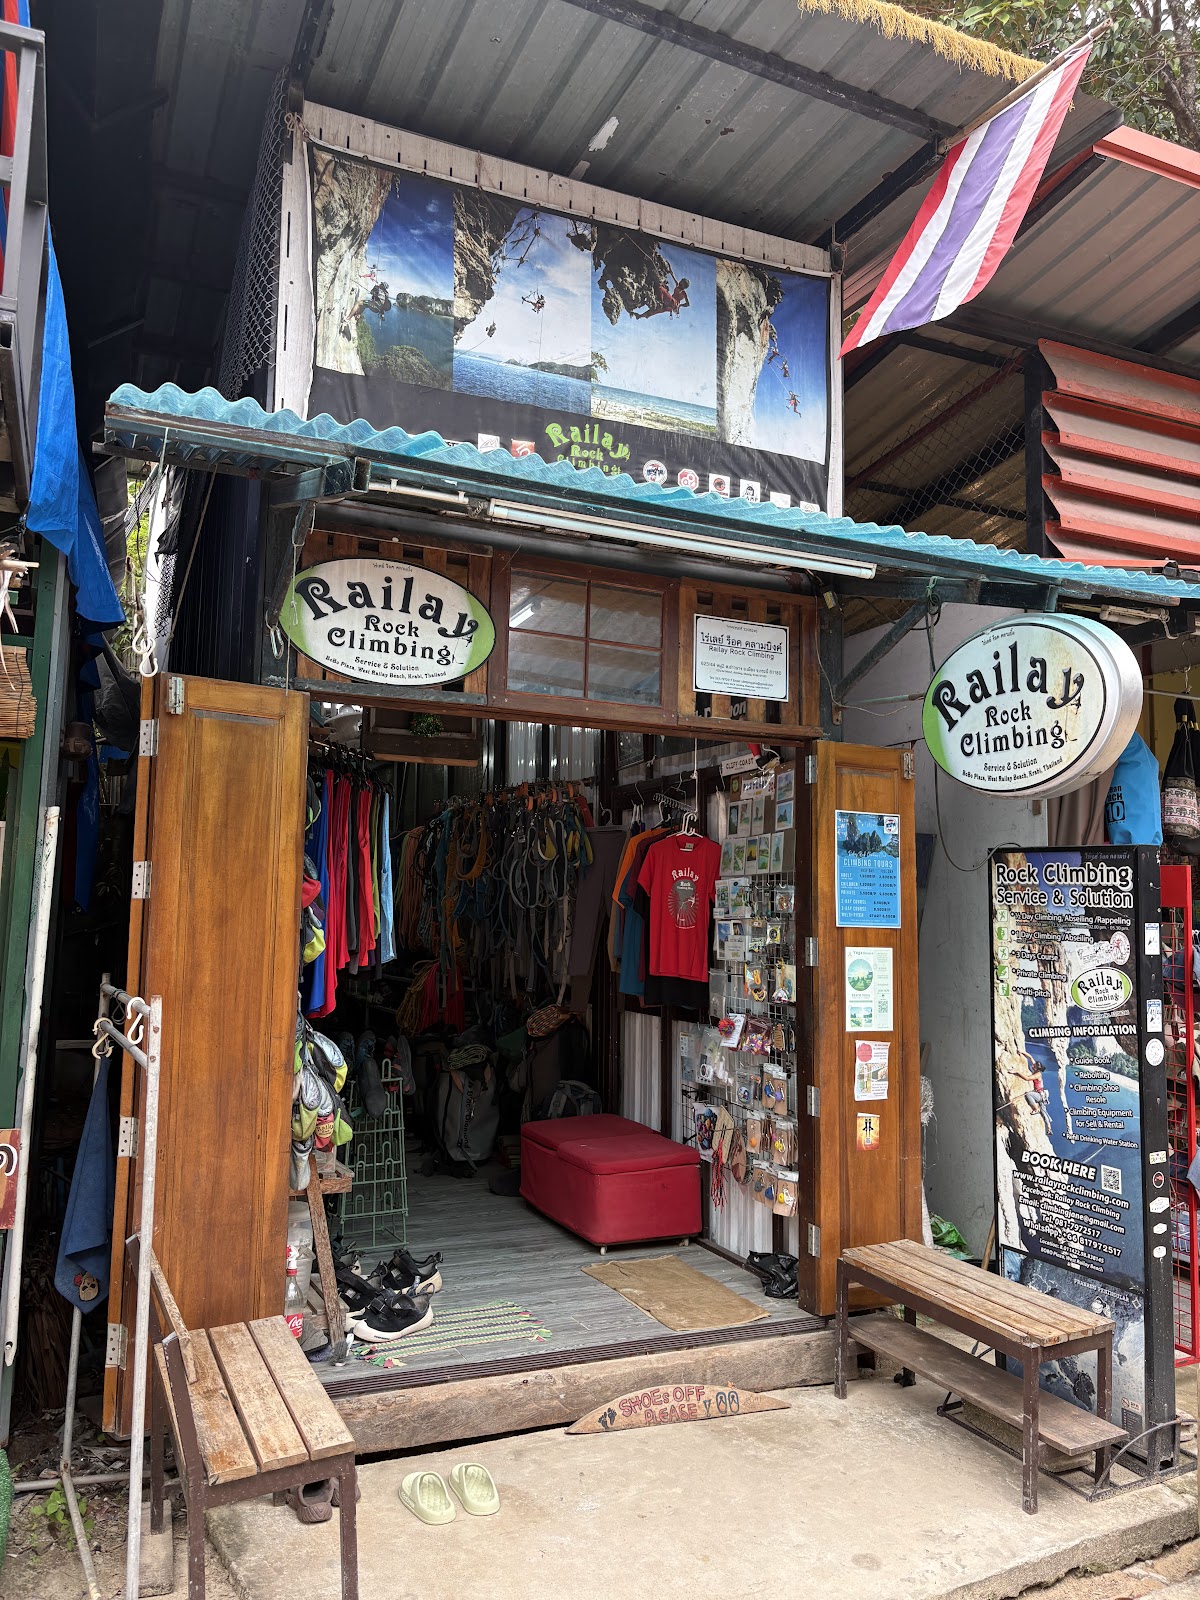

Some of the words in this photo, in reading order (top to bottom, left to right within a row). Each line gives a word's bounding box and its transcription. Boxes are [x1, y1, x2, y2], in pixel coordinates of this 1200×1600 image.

[545, 423, 631, 461] Railay
[570, 444, 604, 461] Rock
[295, 575, 479, 638] Railay
[364, 614, 420, 637] Rock
[327, 627, 452, 666] Climbing
[708, 645, 728, 655] Railay
[729, 648, 746, 656] Rock
[747, 650, 775, 661] Climbing
[354, 656, 381, 668] Service
[390, 663, 420, 671] Solution
[931, 641, 1085, 732] Railay
[984, 699, 1032, 727] Rock
[960, 720, 1066, 757] Climbing
[983, 762, 1006, 772] Service
[1006, 761, 1011, 770] &
[1012, 757, 1038, 770] Solution
[843, 858, 872, 867] CLIMBING
[874, 860, 893, 868] TOURS
[671, 867, 699, 882] Railay
[995, 863, 1039, 884] Rock
[1043, 863, 1132, 890] Climbing
[996, 888, 1047, 905] Service
[1052, 889, 1064, 906] &
[1070, 888, 1133, 908] Solution
[1022, 912, 1034, 920] Day
[1020, 931, 1033, 940] Day
[1033, 932, 1061, 941] Climbing
[1021, 952, 1037, 960] Days
[1037, 951, 1059, 961] Course
[1016, 968, 1038, 979] Private
[1039, 970, 1067, 982] Climbing
[1077, 971, 1123, 995] Railay
[1016, 986, 1051, 998] Multi-pitch
[1087, 993, 1119, 1003] Climbing
[1094, 987, 1109, 995] Rock
[1029, 1027, 1071, 1038] CLIMBING
[1073, 1025, 1137, 1036] INFORMATION
[1074, 1057, 1094, 1065] Guide
[1079, 1071, 1110, 1080] Rebolting
[1074, 1083, 1103, 1093] Climbing
[1103, 1083, 1120, 1092] Shoe
[1085, 1095, 1107, 1104] Resole
[1069, 1108, 1097, 1118] Climbing
[1097, 1108, 1133, 1118] Equipment
[463, 1114, 472, 1149] Diamond
[1075, 1120, 1085, 1128] for
[1085, 1120, 1097, 1128] Sell
[1103, 1120, 1125, 1129] Rental
[1066, 1133, 1079, 1141] Refill
[1079, 1135, 1103, 1146] Drinking
[1103, 1137, 1119, 1146] Water
[1118, 1139, 1139, 1149] Station
[1021, 1151, 1060, 1171] BOOK
[1062, 1160, 1097, 1180] HERE
[1013, 1170, 1130, 1209] www.railayrockclimbing.com
[1022, 1184, 1054, 1200] Facebook:
[1054, 1193, 1075, 1205] Railay
[1075, 1198, 1091, 1210] Rock
[1091, 1204, 1121, 1221] Climbing
[1019, 1195, 1040, 1208] Email:
[1040, 1202, 1126, 1235] climbingjane@gmail.com
[1054, 1216, 1101, 1238] 081-7972517
[1023, 1218, 1062, 1239] WhatsApp:
[1062, 1231, 1079, 1243] +66
[1079, 1236, 1122, 1257] 817972517
[672, 1385, 706, 1402] OFF
[644, 1402, 699, 1425] PLEASE
